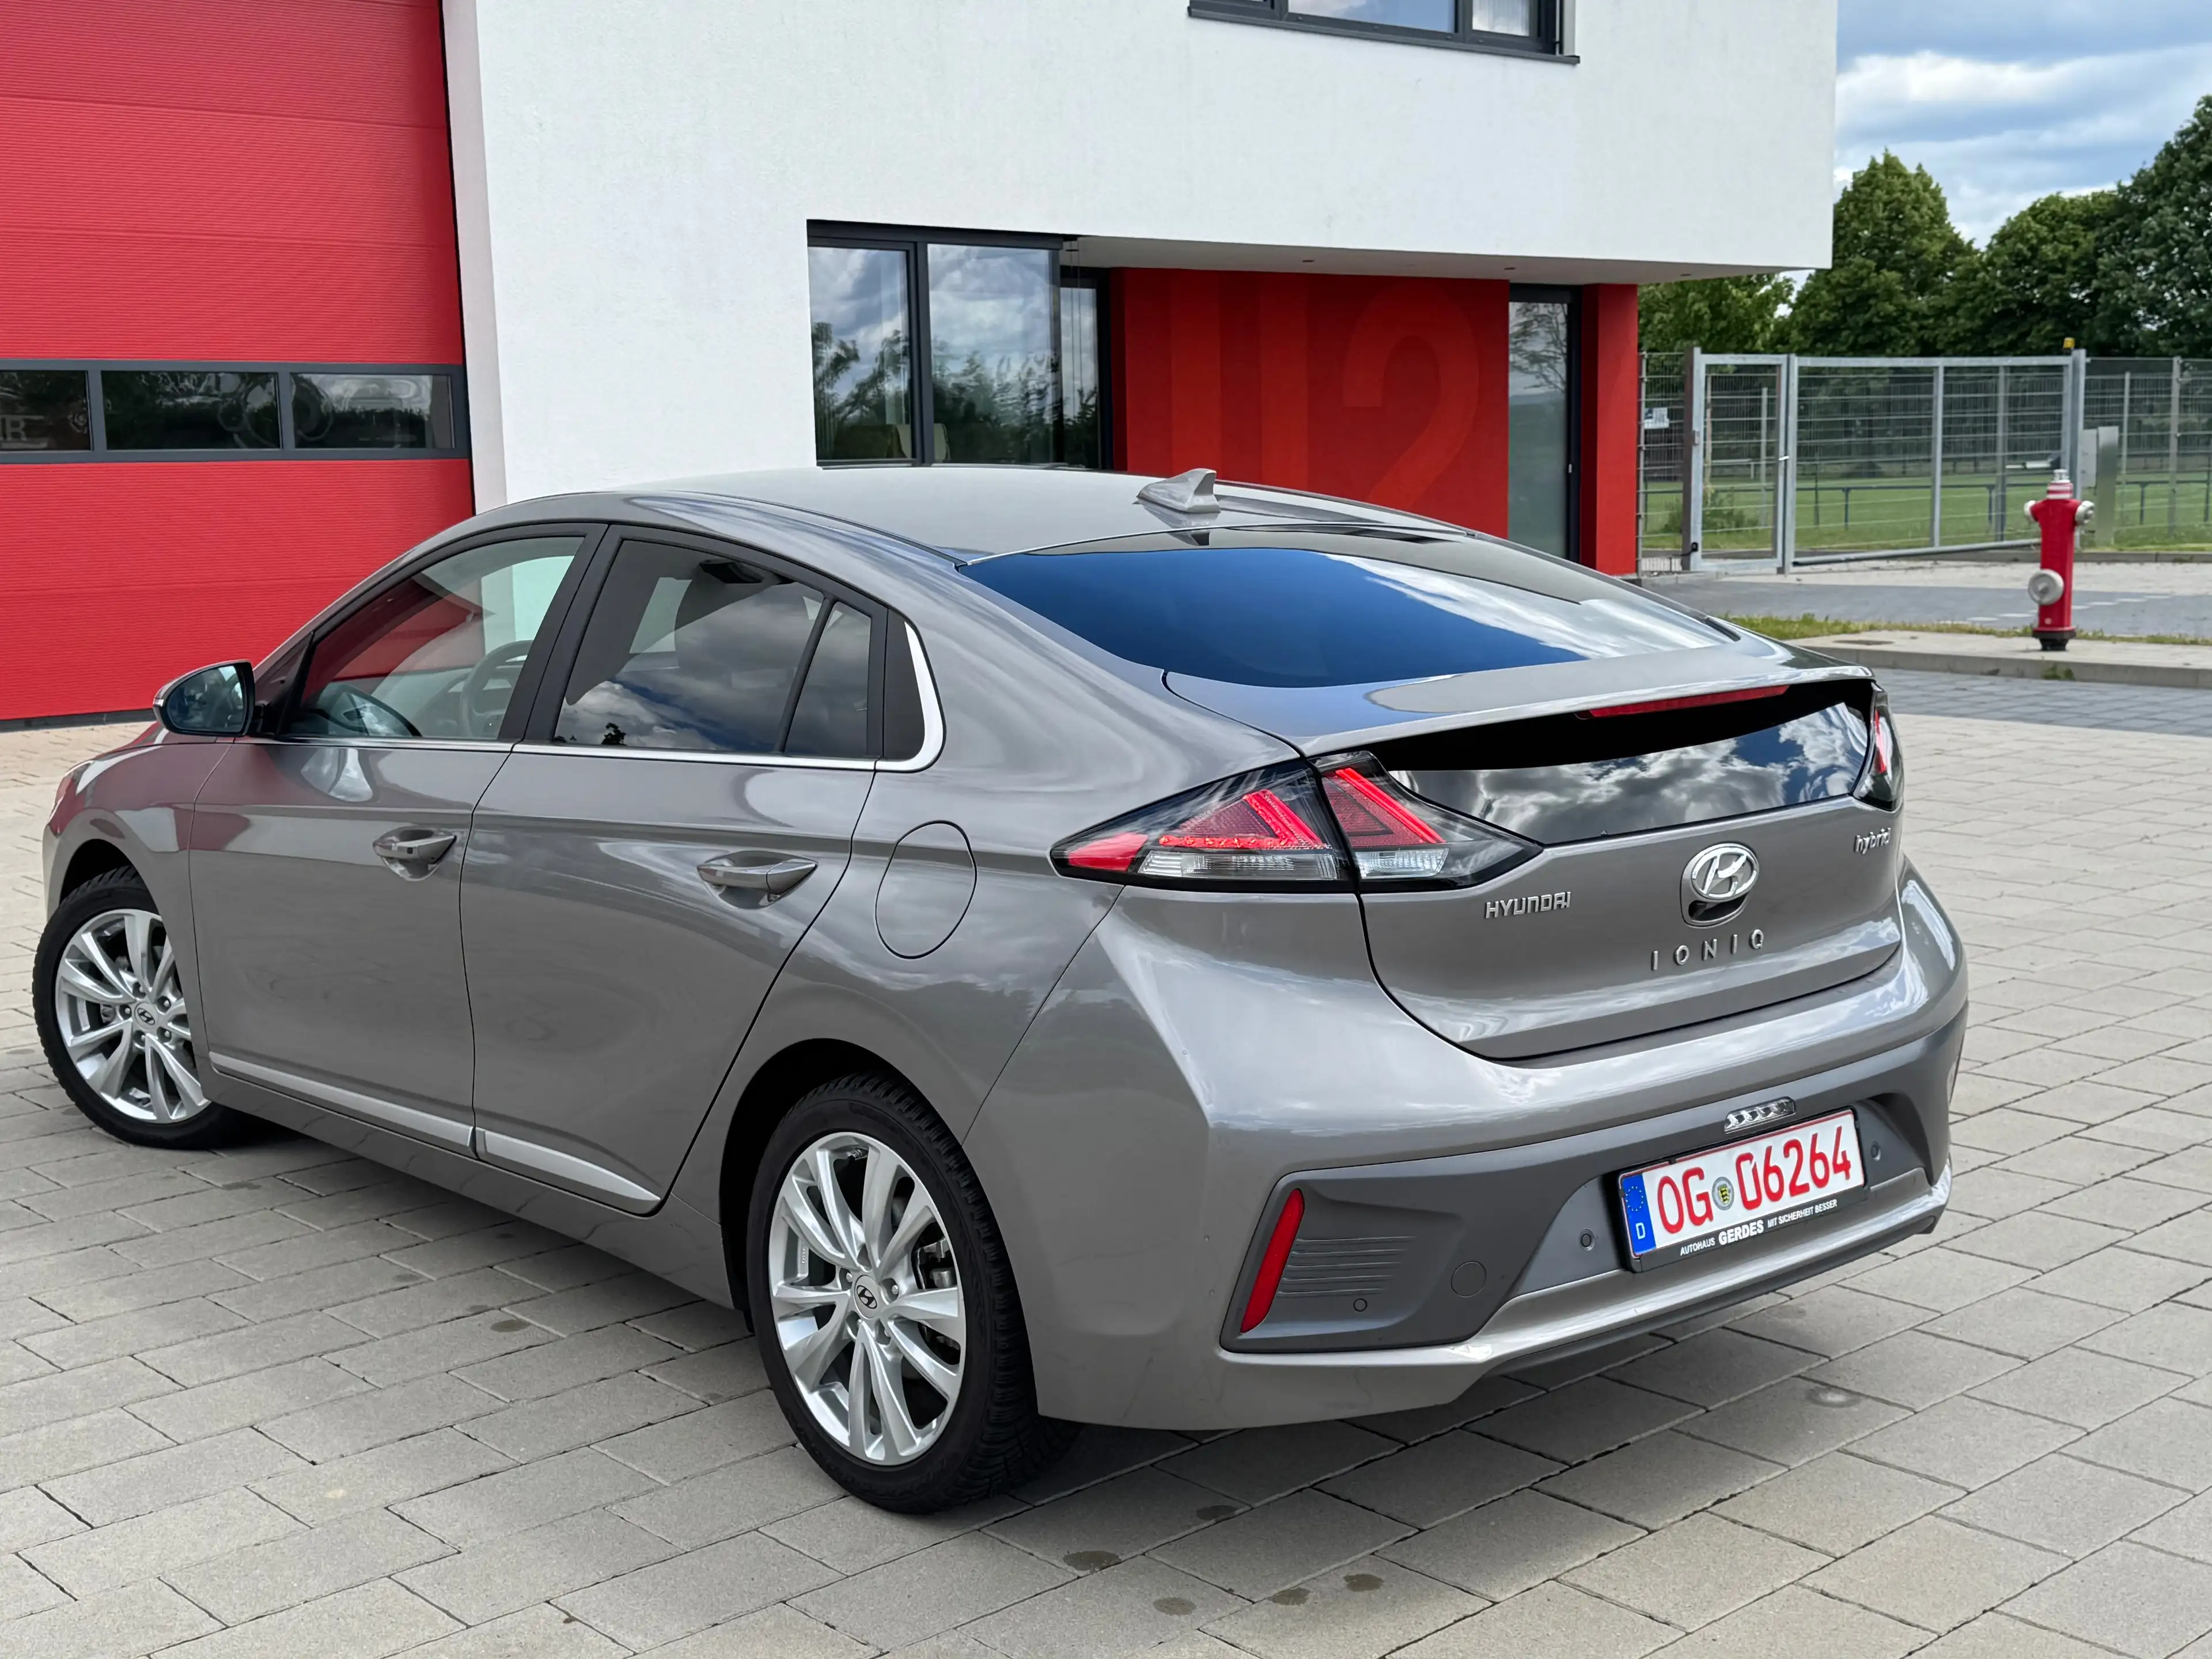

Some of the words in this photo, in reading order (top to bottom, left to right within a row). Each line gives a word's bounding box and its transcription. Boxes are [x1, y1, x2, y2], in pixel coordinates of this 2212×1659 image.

[1854, 827, 1891, 855] hybrid
[1484, 891, 1572, 919] HYUNDAI
[1651, 929, 1765, 971] IONIQ
[1657, 1166, 1714, 1234] OG
[1735, 1126, 1852, 1211] 06264
[1635, 1222, 1646, 1240] D
[1680, 1237, 1715, 1256] AUTOHAUS
[1718, 1219, 1764, 1245] GERDES
[1767, 1217, 1779, 1229] MIT
[1779, 1206, 1814, 1225] SICHERHEIT
[1815, 1199, 1838, 1214] BESSER
